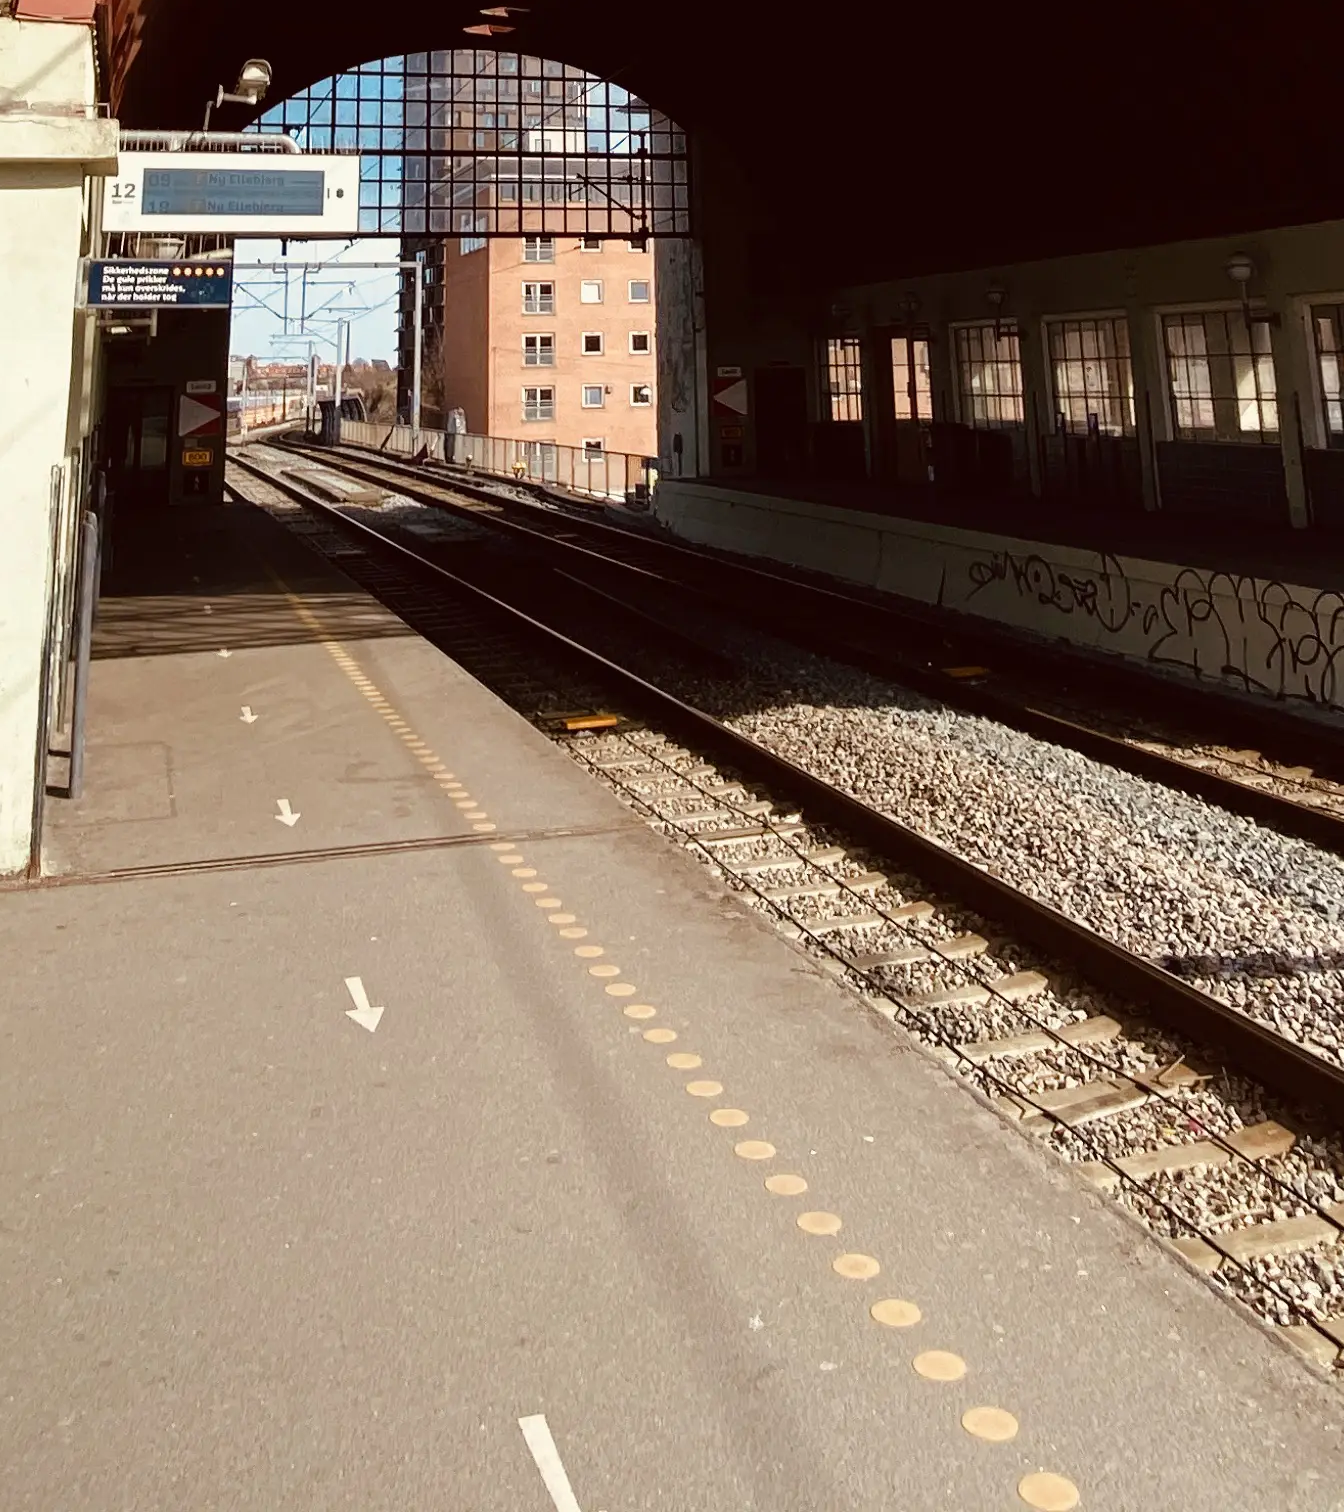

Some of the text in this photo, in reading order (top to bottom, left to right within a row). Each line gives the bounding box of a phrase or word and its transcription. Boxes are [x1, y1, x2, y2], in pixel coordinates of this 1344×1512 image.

[208, 173, 225, 187] Ny
[111, 183, 136, 199] 12
[103, 266, 170, 275] Sikkerhedszone
[102, 275, 167, 285] De gule prikker
[101, 284, 187, 293] må kun overskrides,
[101, 292, 177, 302] når der holder tog
